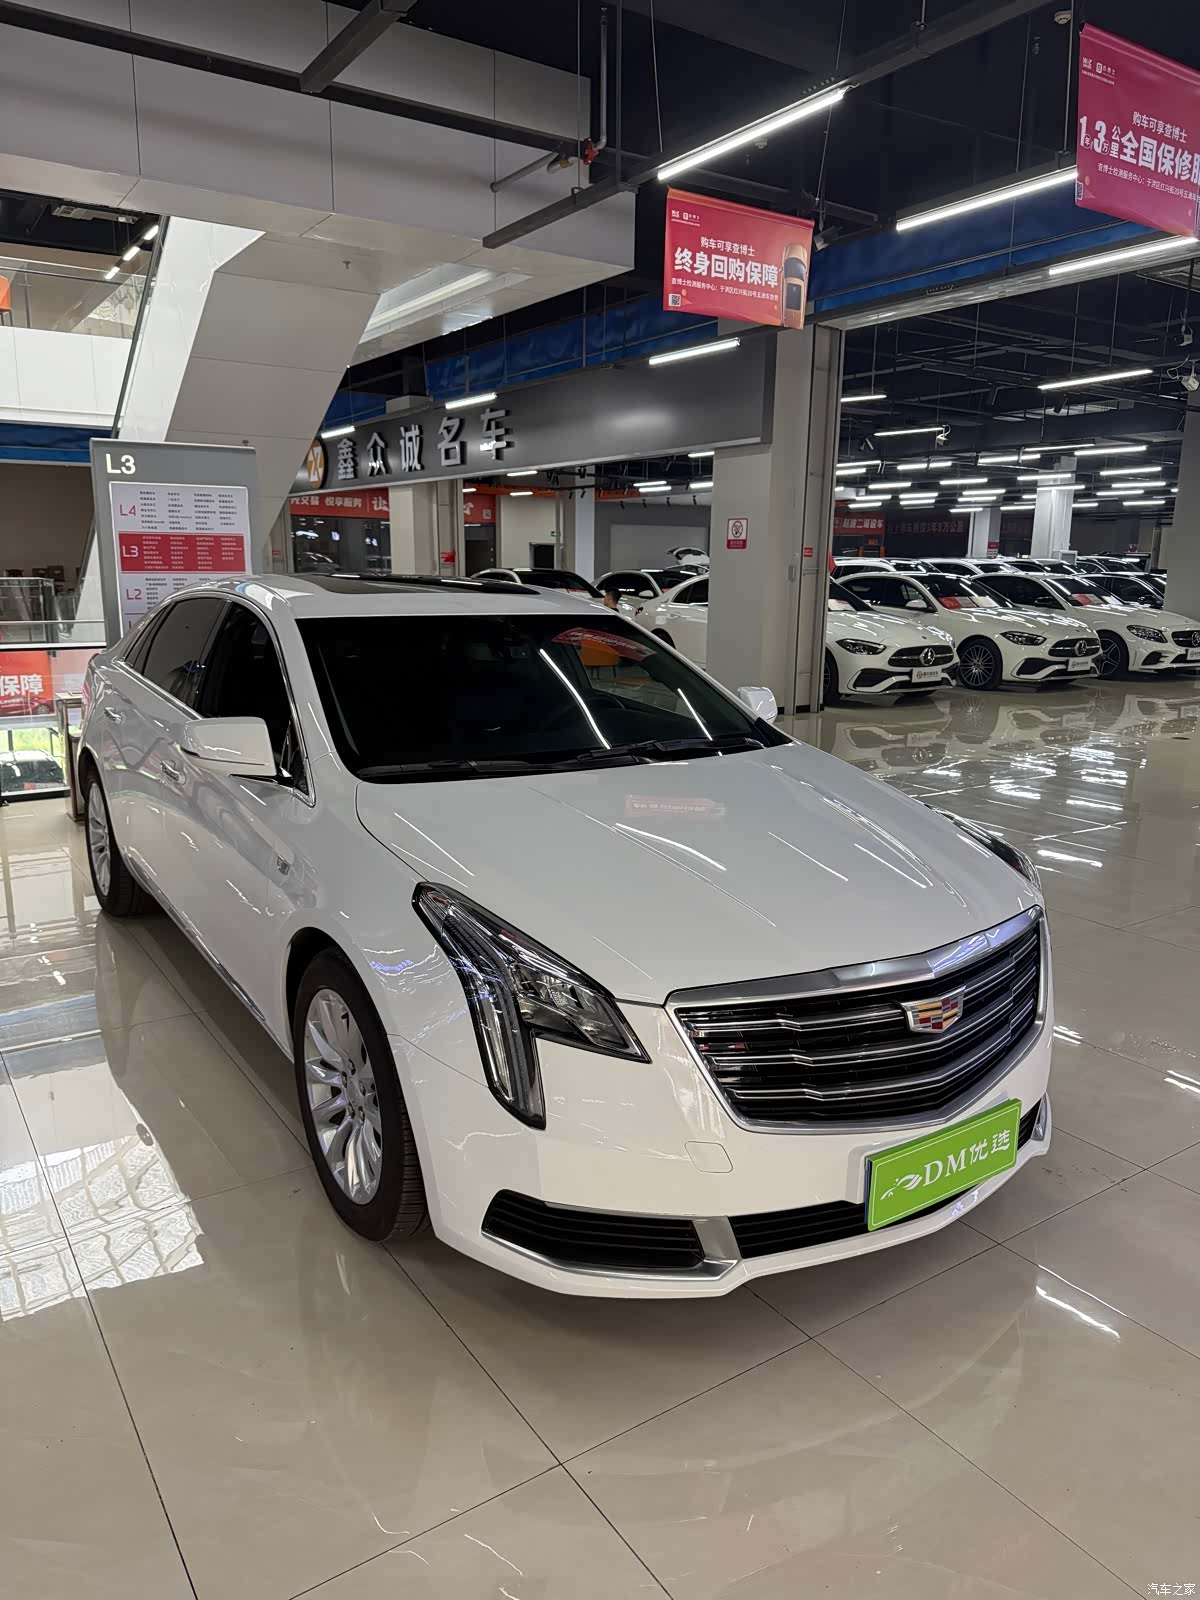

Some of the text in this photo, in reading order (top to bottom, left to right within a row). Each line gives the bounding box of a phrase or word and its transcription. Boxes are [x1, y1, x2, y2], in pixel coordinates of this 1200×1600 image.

[1132, 111, 1188, 143] 购车可享查博士
[700, 236, 756, 257] 购车可享查博士
[674, 247, 779, 288] 终身回购保障
[336, 408, 507, 480] 鑫众诚名车
[105, 453, 136, 475] L3
[119, 504, 137, 516] L4
[122, 545, 139, 558] L3
[126, 588, 142, 600] L2
[0, 673, 44, 697] 保障
